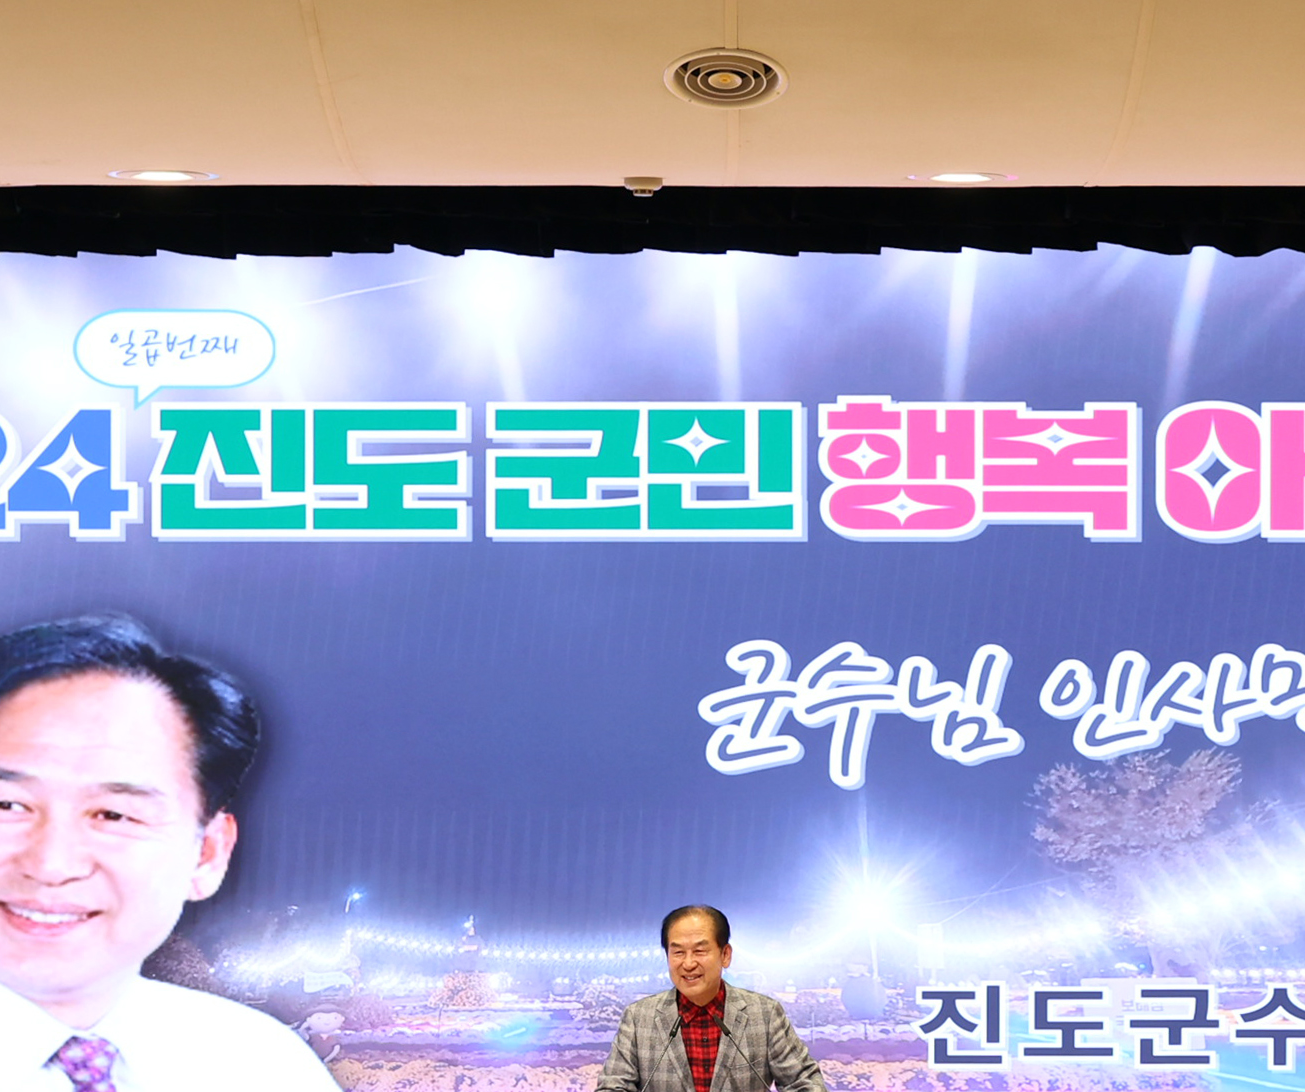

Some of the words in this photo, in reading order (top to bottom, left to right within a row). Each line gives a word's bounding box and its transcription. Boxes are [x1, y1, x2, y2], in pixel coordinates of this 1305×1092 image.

[109, 328, 239, 368] 일곱번째
[156, 406, 461, 532] 진도
[493, 406, 798, 532] 군민
[819, 400, 1131, 533] 행복
[706, 645, 1017, 781] 군수님
